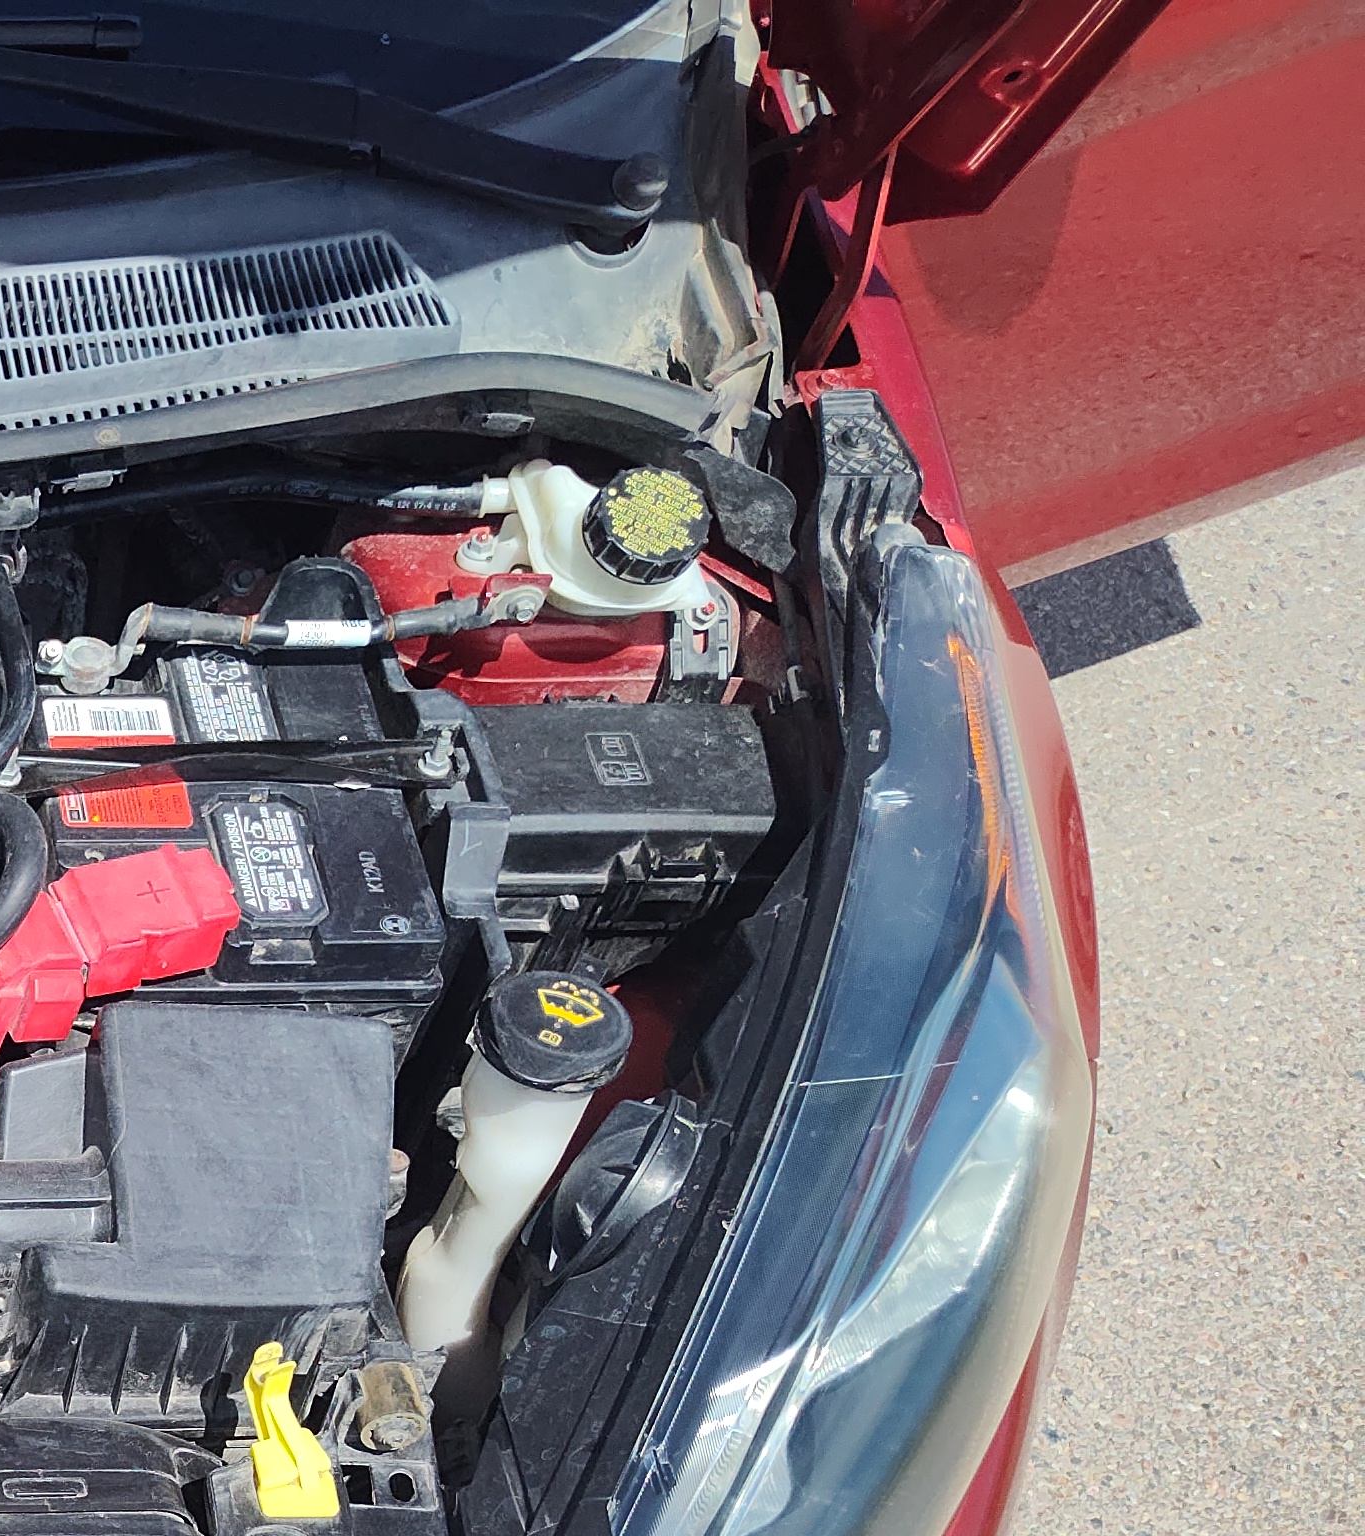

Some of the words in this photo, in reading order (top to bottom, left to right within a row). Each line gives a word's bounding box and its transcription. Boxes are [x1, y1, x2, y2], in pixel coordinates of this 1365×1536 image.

[630, 488, 656, 505] SEALED
[631, 472, 658, 489] BEFORE
[641, 469, 664, 485] CLEAN
[662, 480, 685, 495] FILLER
[683, 490, 699, 502] CAP
[605, 499, 629, 515] AVANT
[624, 477, 644, 491] ONLY
[643, 486, 657, 497] DOT
[664, 496, 684, 510] FLUID
[683, 506, 703, 520] FROM
[615, 496, 649, 517] NETTOYER
[648, 512, 658, 521] LE
[656, 516, 689, 536] BOUCHON
[633, 521, 649, 532] QUE
[223, 813, 242, 849] POISON
[235, 859, 256, 897] DANGER
